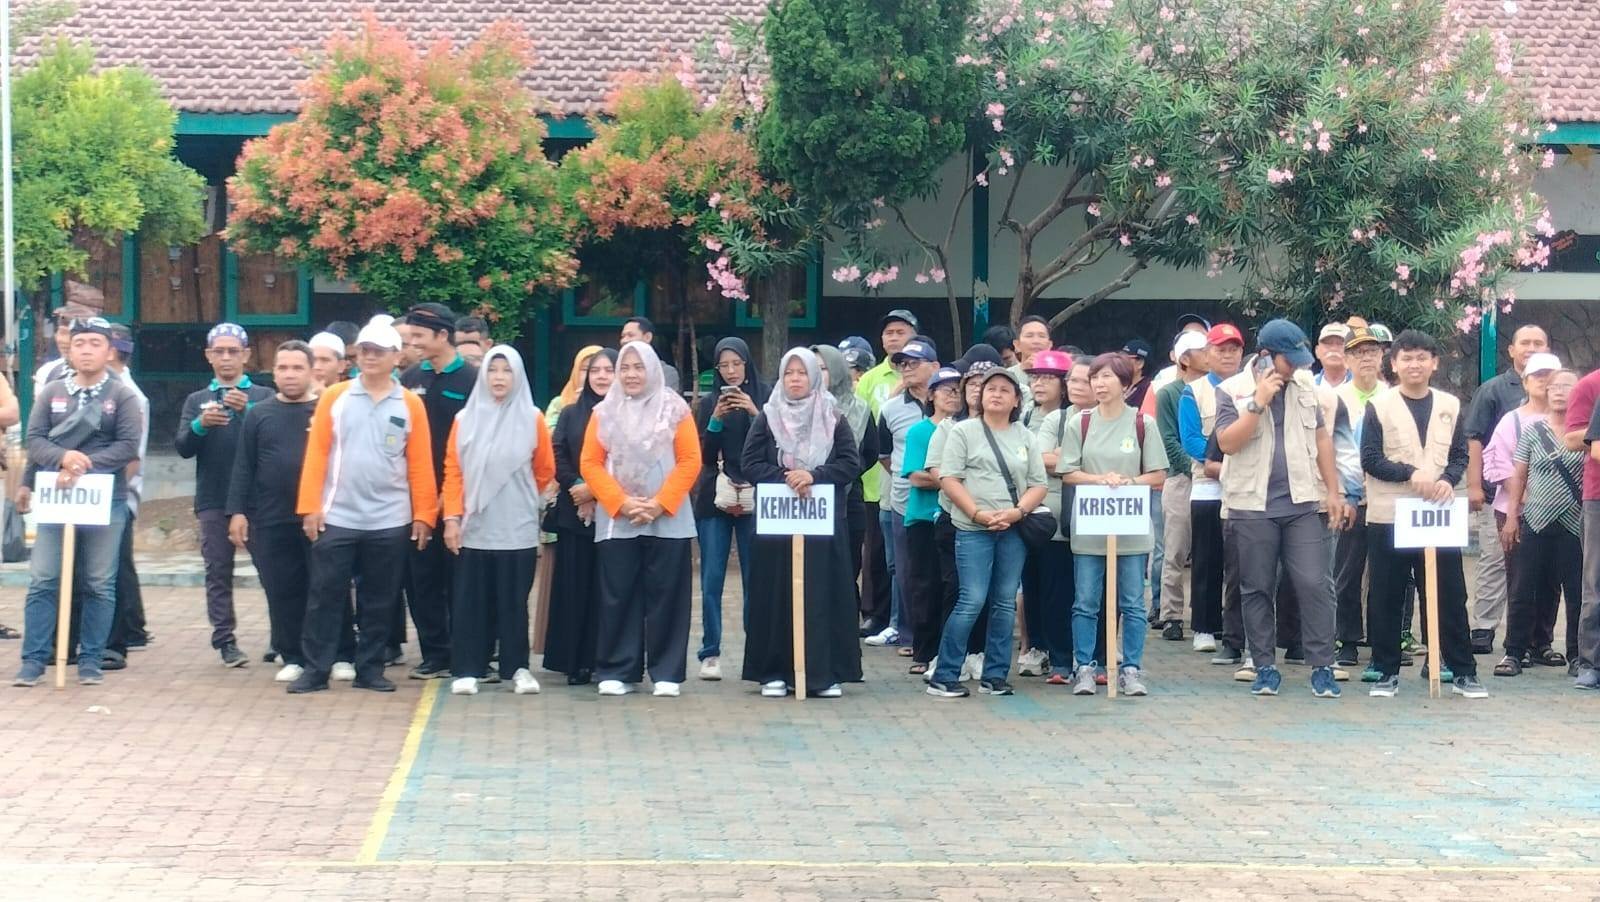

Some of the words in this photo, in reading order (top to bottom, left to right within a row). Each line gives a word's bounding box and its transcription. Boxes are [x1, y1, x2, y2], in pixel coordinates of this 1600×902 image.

[40, 487, 101, 505] HINDU
[760, 496, 827, 520] KEMENAG
[1079, 497, 1143, 516] KRISTEN
[1411, 509, 1451, 527] LDII
